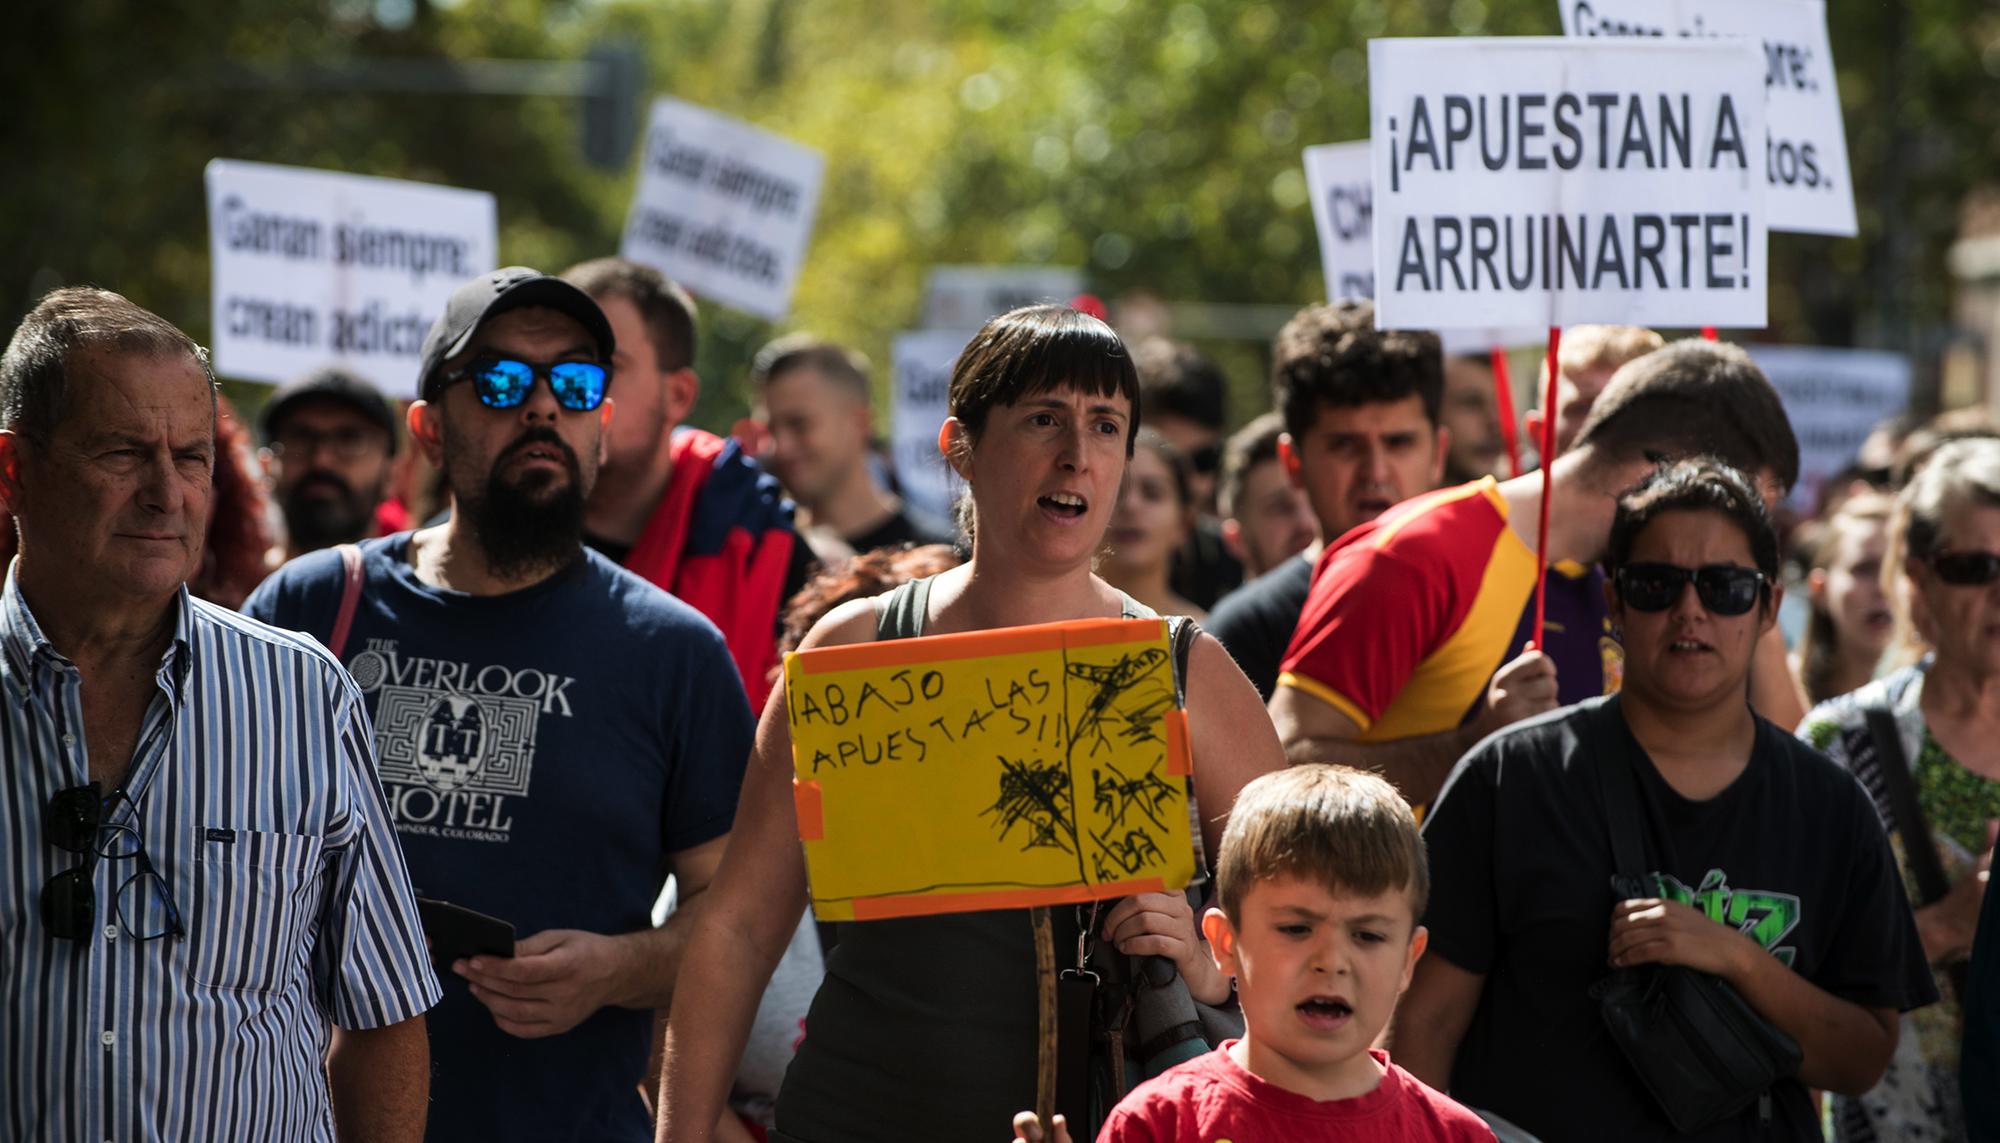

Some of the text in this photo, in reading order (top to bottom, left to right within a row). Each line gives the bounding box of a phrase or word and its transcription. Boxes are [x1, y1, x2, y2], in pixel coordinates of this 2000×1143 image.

[1389, 92, 1749, 192] ¡APUESTAN A
[222, 194, 322, 260] Ganan
[1395, 212, 1750, 293] ARRUINARTE!
[224, 294, 317, 347] crean
[363, 637, 401, 652] THE
[350, 650, 576, 718] OVERLOOK
[984, 667, 1051, 710] LAS
[387, 784, 514, 832] HOTEL
[440, 826, 511, 843] COLORADO
